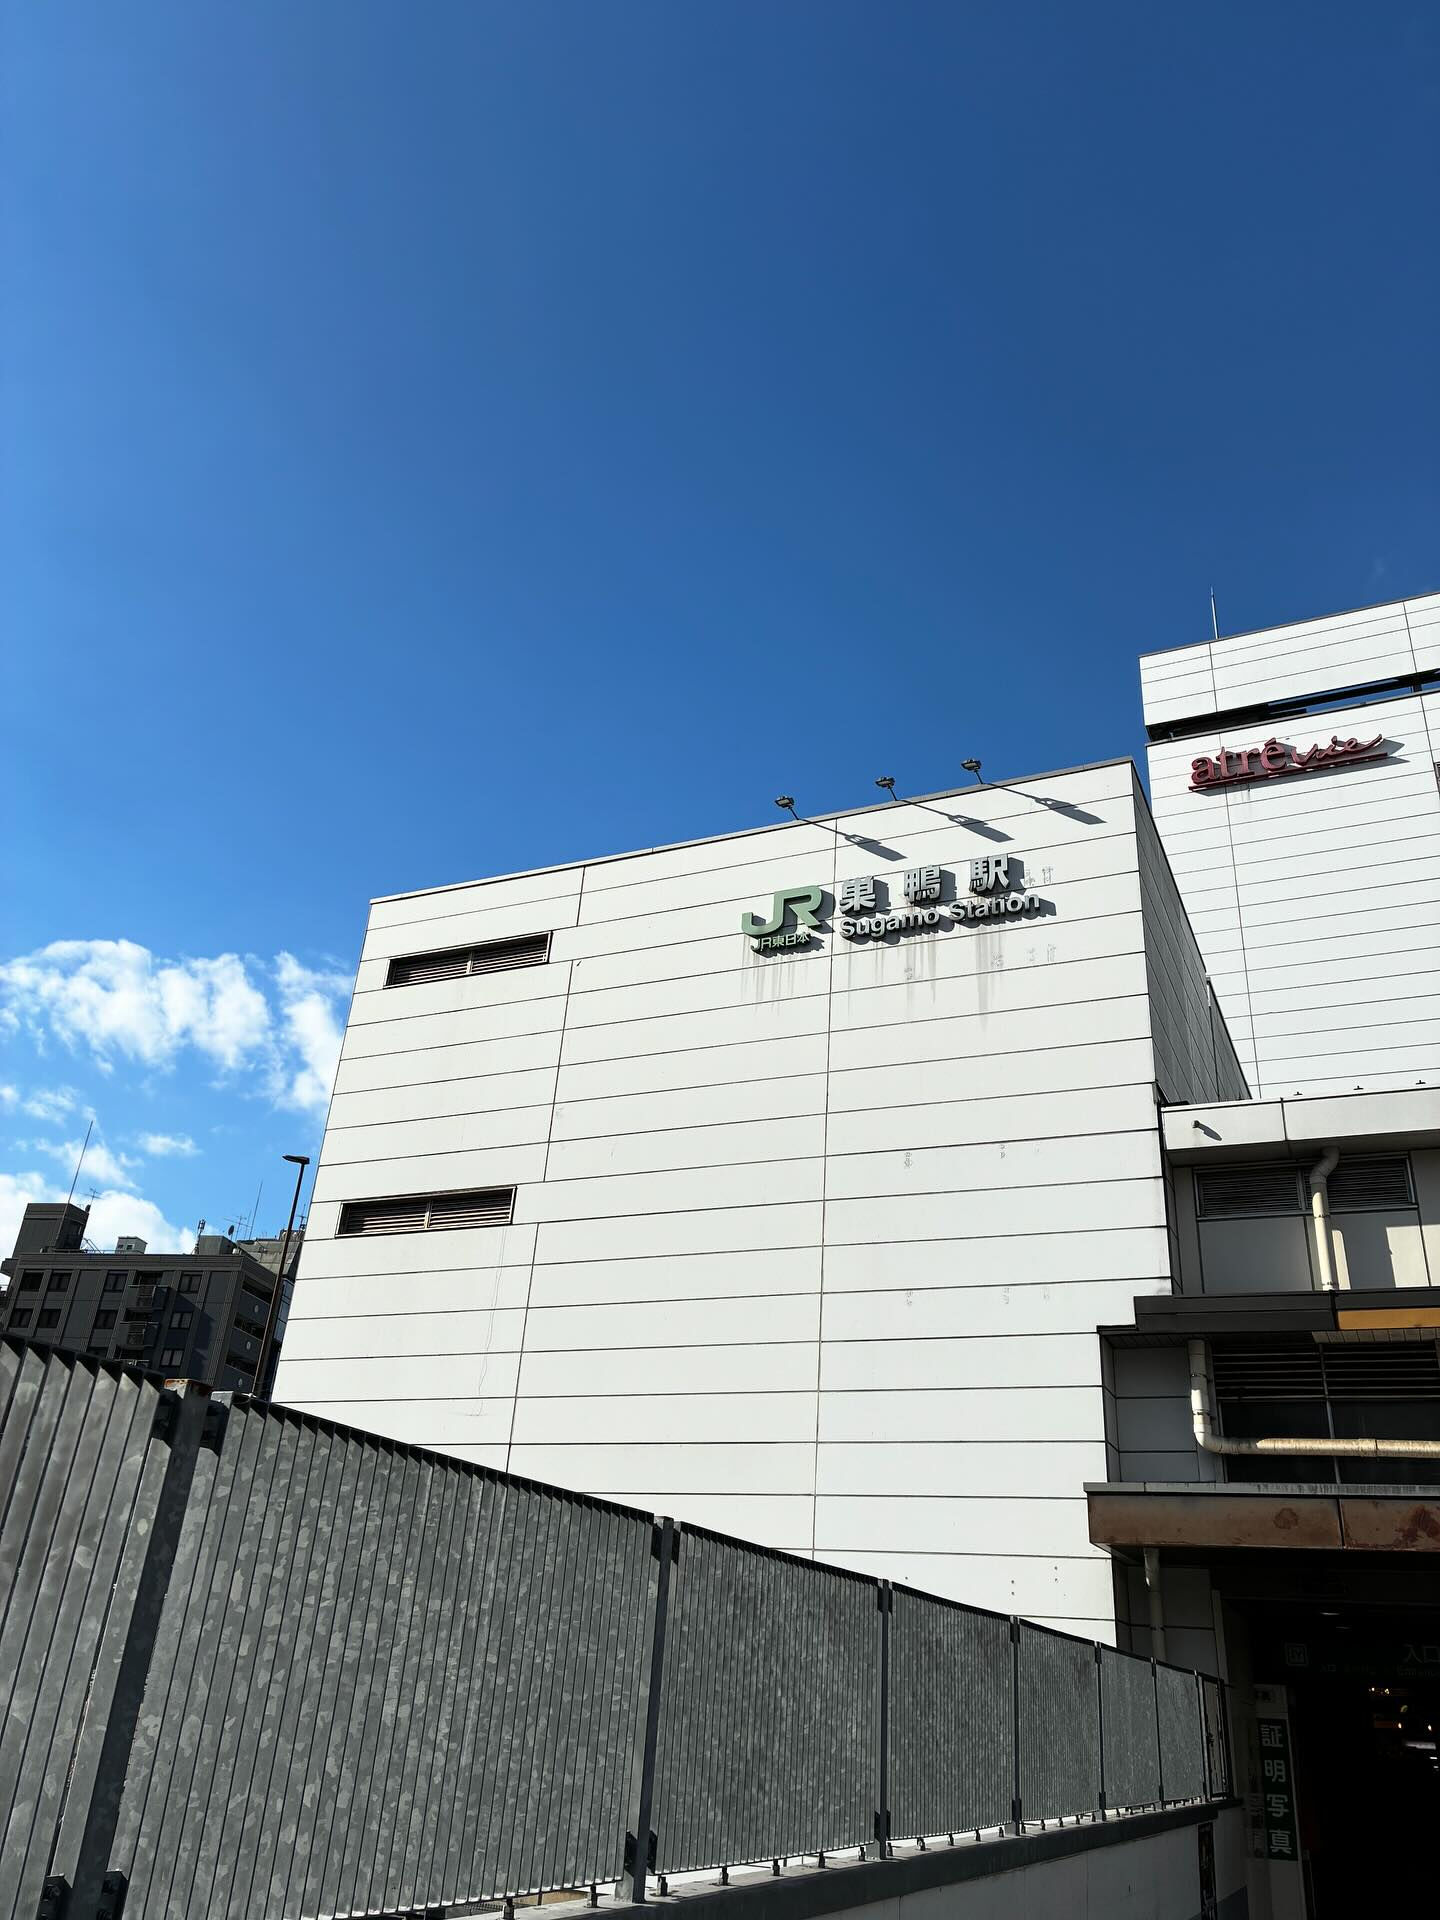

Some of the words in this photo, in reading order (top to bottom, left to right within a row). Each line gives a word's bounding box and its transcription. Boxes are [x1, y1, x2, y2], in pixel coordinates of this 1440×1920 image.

[1290, 733, 1383, 767] vie
[839, 853, 1010, 912] 巣鴨駅
[741, 885, 822, 936] JR
[839, 907, 940, 938] Sugamo
[950, 893, 1041, 922] Station
[750, 931, 810, 952] JR東日本
[1260, 1724, 1292, 1854] 証明写真
